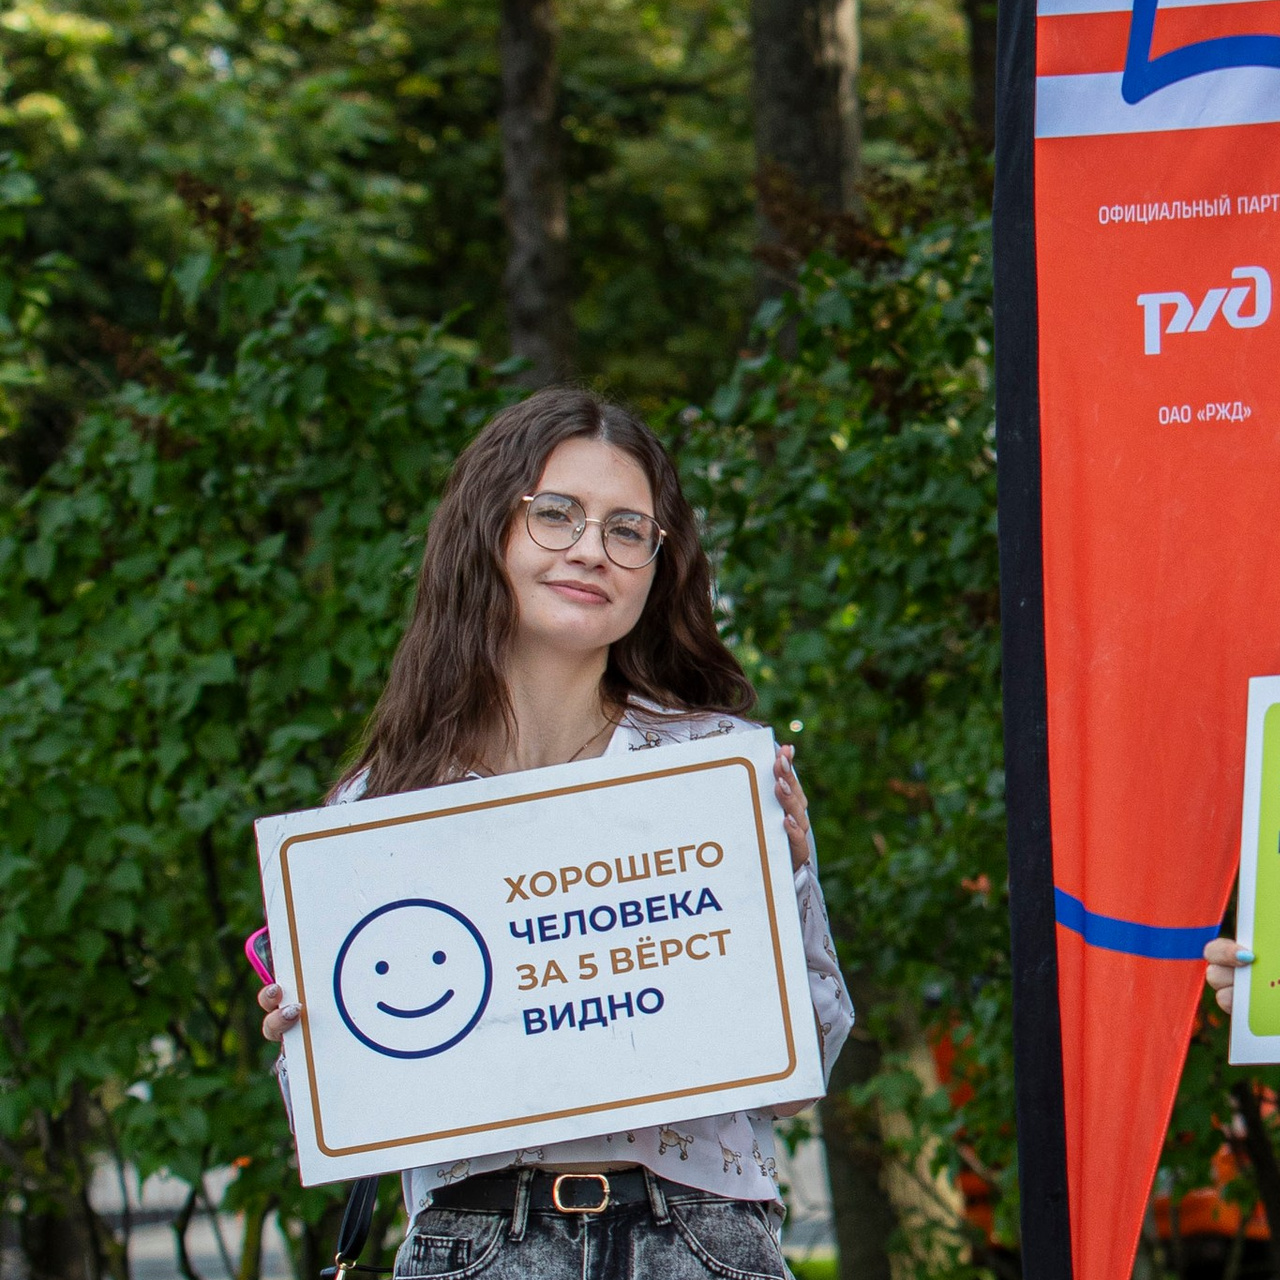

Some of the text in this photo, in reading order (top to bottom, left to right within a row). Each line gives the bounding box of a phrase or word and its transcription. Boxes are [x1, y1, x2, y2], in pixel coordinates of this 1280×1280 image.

[1097, 193, 1232, 225] ОФИЦИАЛЬНЫЙ
[1158, 401, 1253, 426] ОАО «РЖД»
[503, 840, 724, 903] ХОРОШЕГО
[509, 886, 723, 945] ЧЕЛОВЕКА
[515, 928, 732, 991] ЗА 5 ВЁРСТ
[522, 986, 666, 1036] ВИДНО
